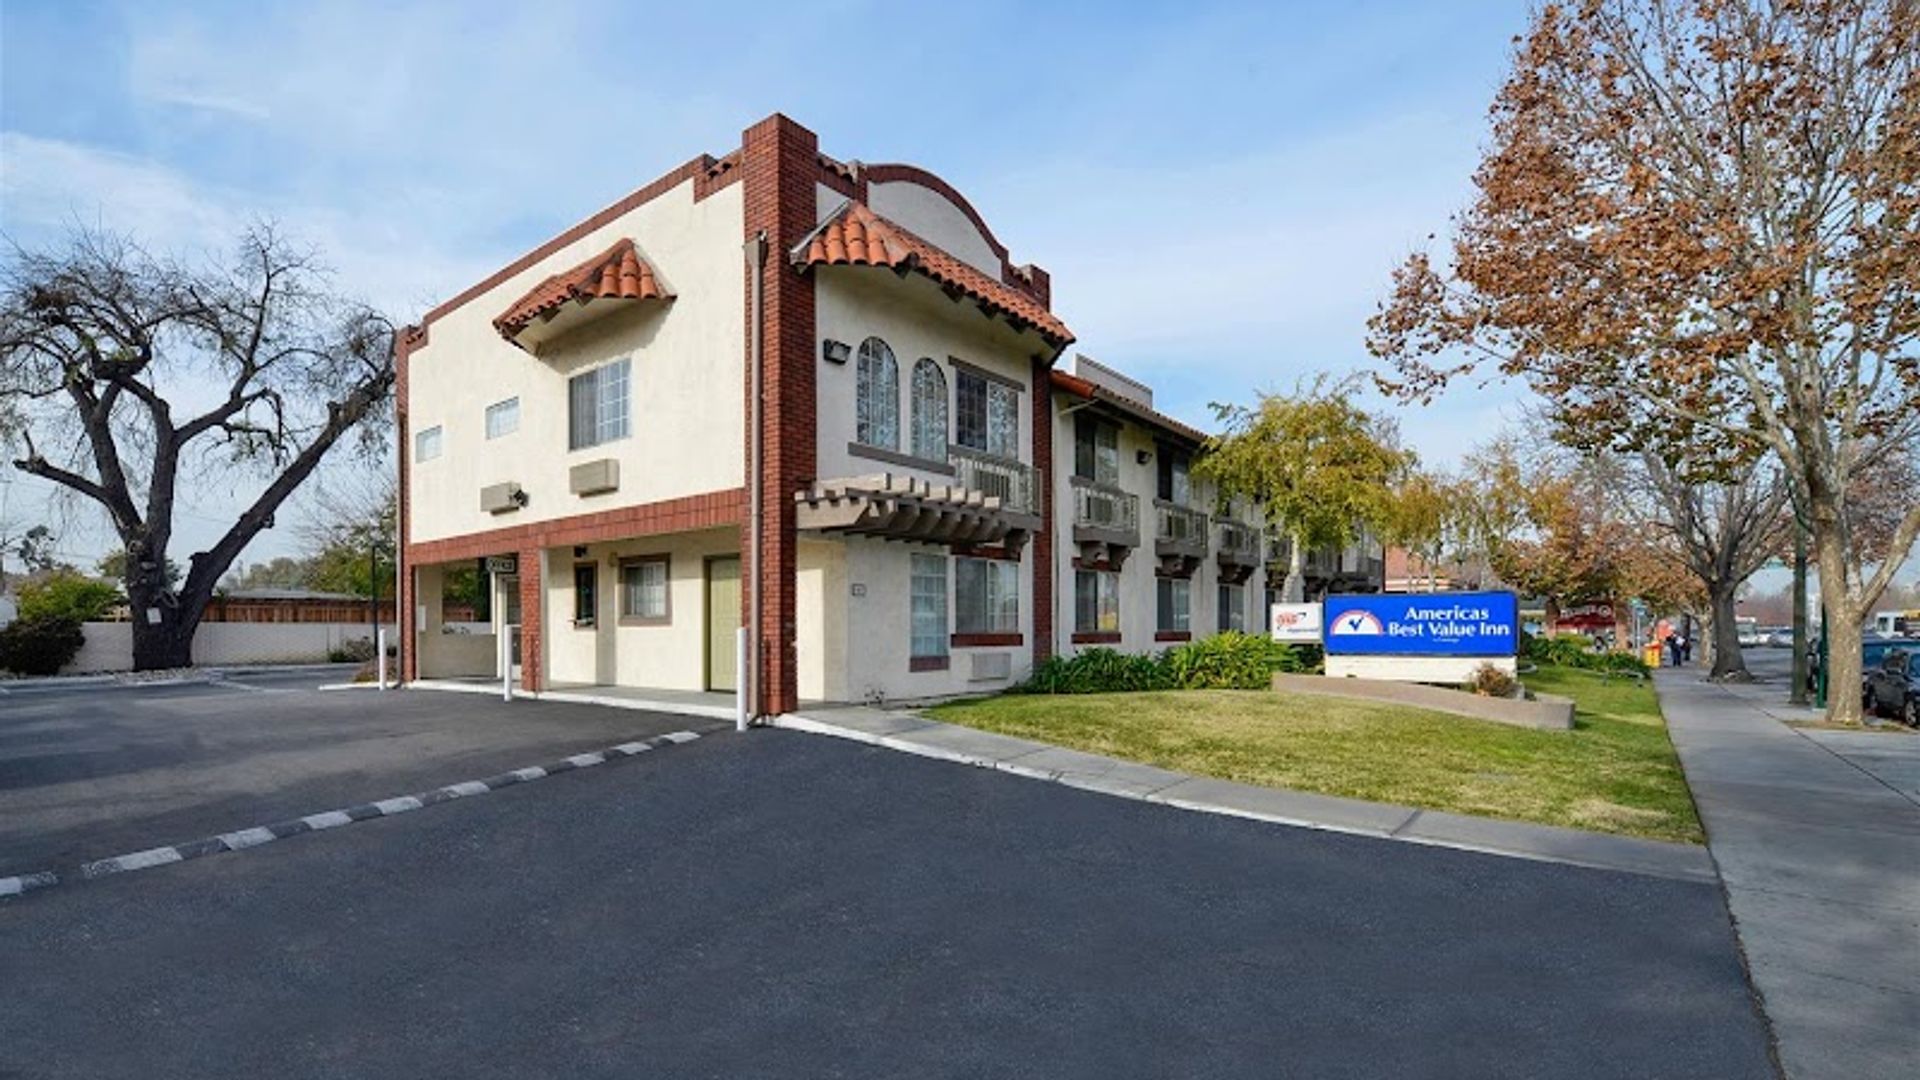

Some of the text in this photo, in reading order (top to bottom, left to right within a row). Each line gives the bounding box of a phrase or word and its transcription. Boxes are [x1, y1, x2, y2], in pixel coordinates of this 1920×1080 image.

[1404, 604, 1489, 620] Americas
[1388, 620, 1510, 637] Best Value Inn
